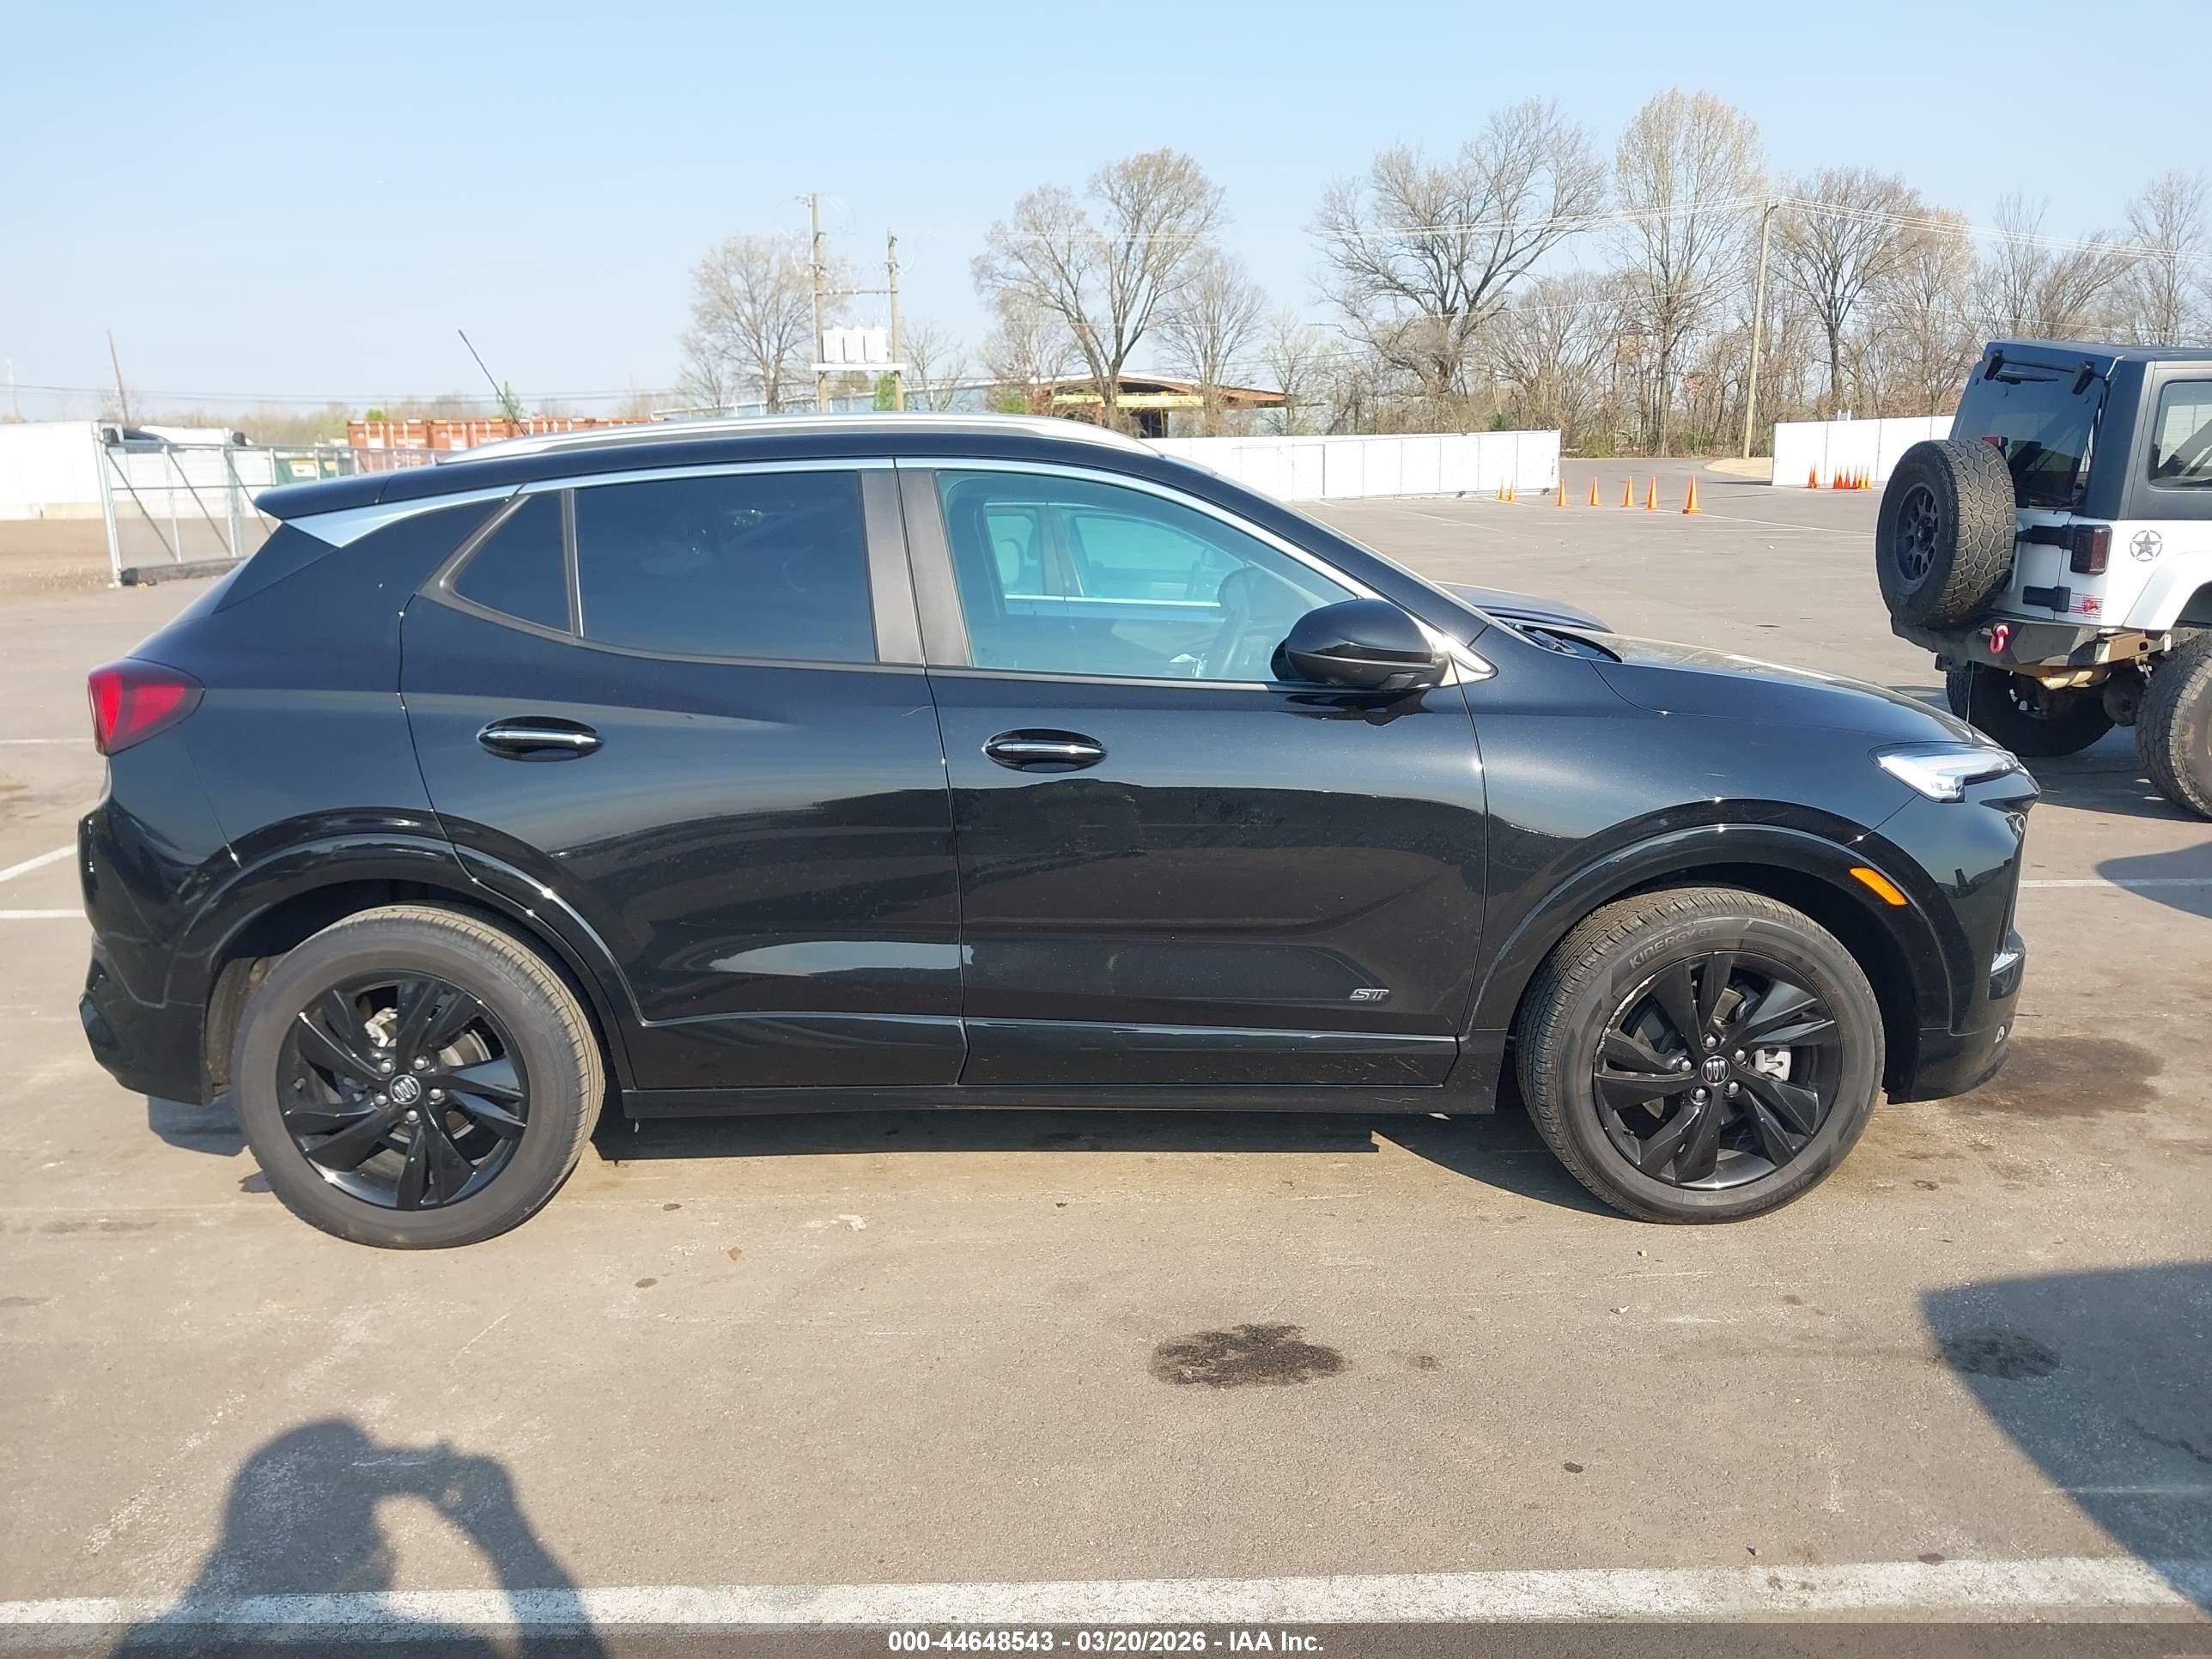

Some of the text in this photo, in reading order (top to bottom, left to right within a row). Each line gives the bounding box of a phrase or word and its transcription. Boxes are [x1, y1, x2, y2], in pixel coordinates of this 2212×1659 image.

[1629, 927, 1716, 969] KINERGY GT
[1349, 988, 1389, 1001] ST
